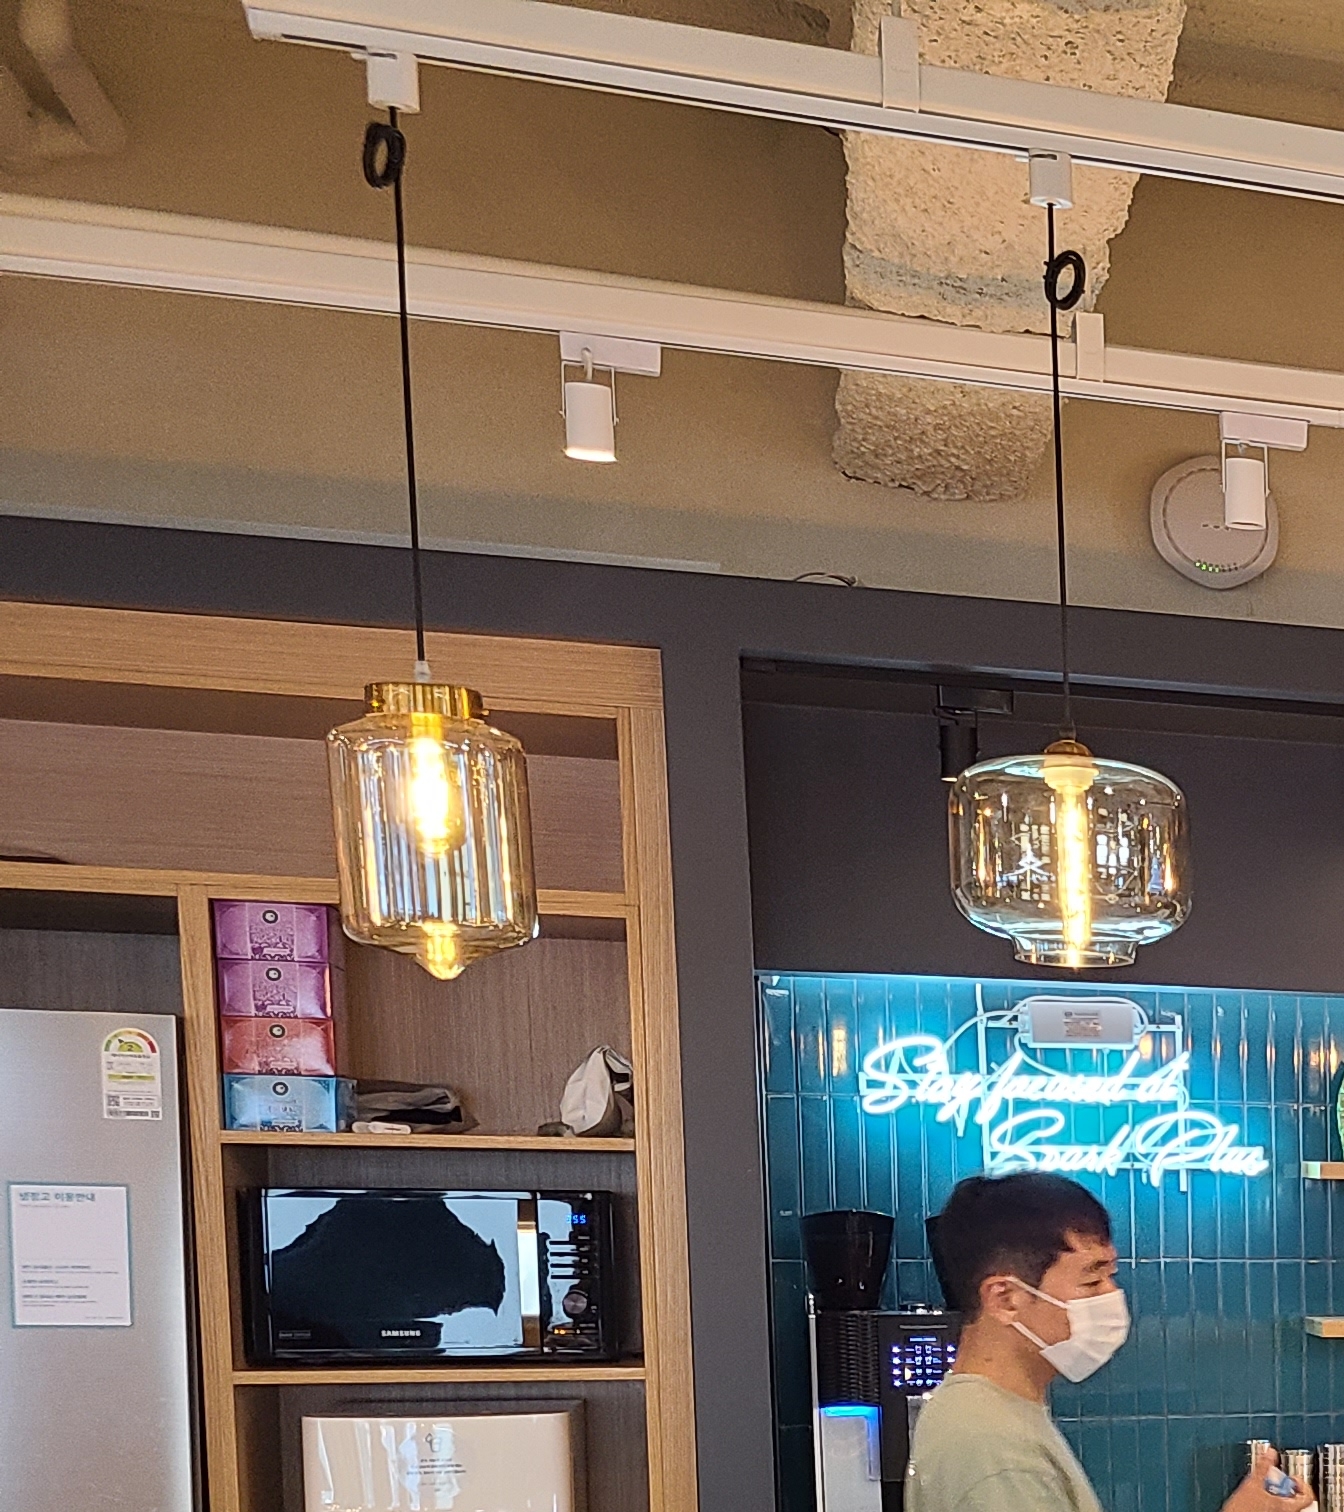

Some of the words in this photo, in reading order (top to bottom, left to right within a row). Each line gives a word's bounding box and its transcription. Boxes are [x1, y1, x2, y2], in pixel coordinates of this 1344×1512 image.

[862, 1035, 986, 1122] Stay
[974, 1050, 1141, 1124] focused
[1134, 1050, 1190, 1102] at
[1134, 1110, 1270, 1188] Plus
